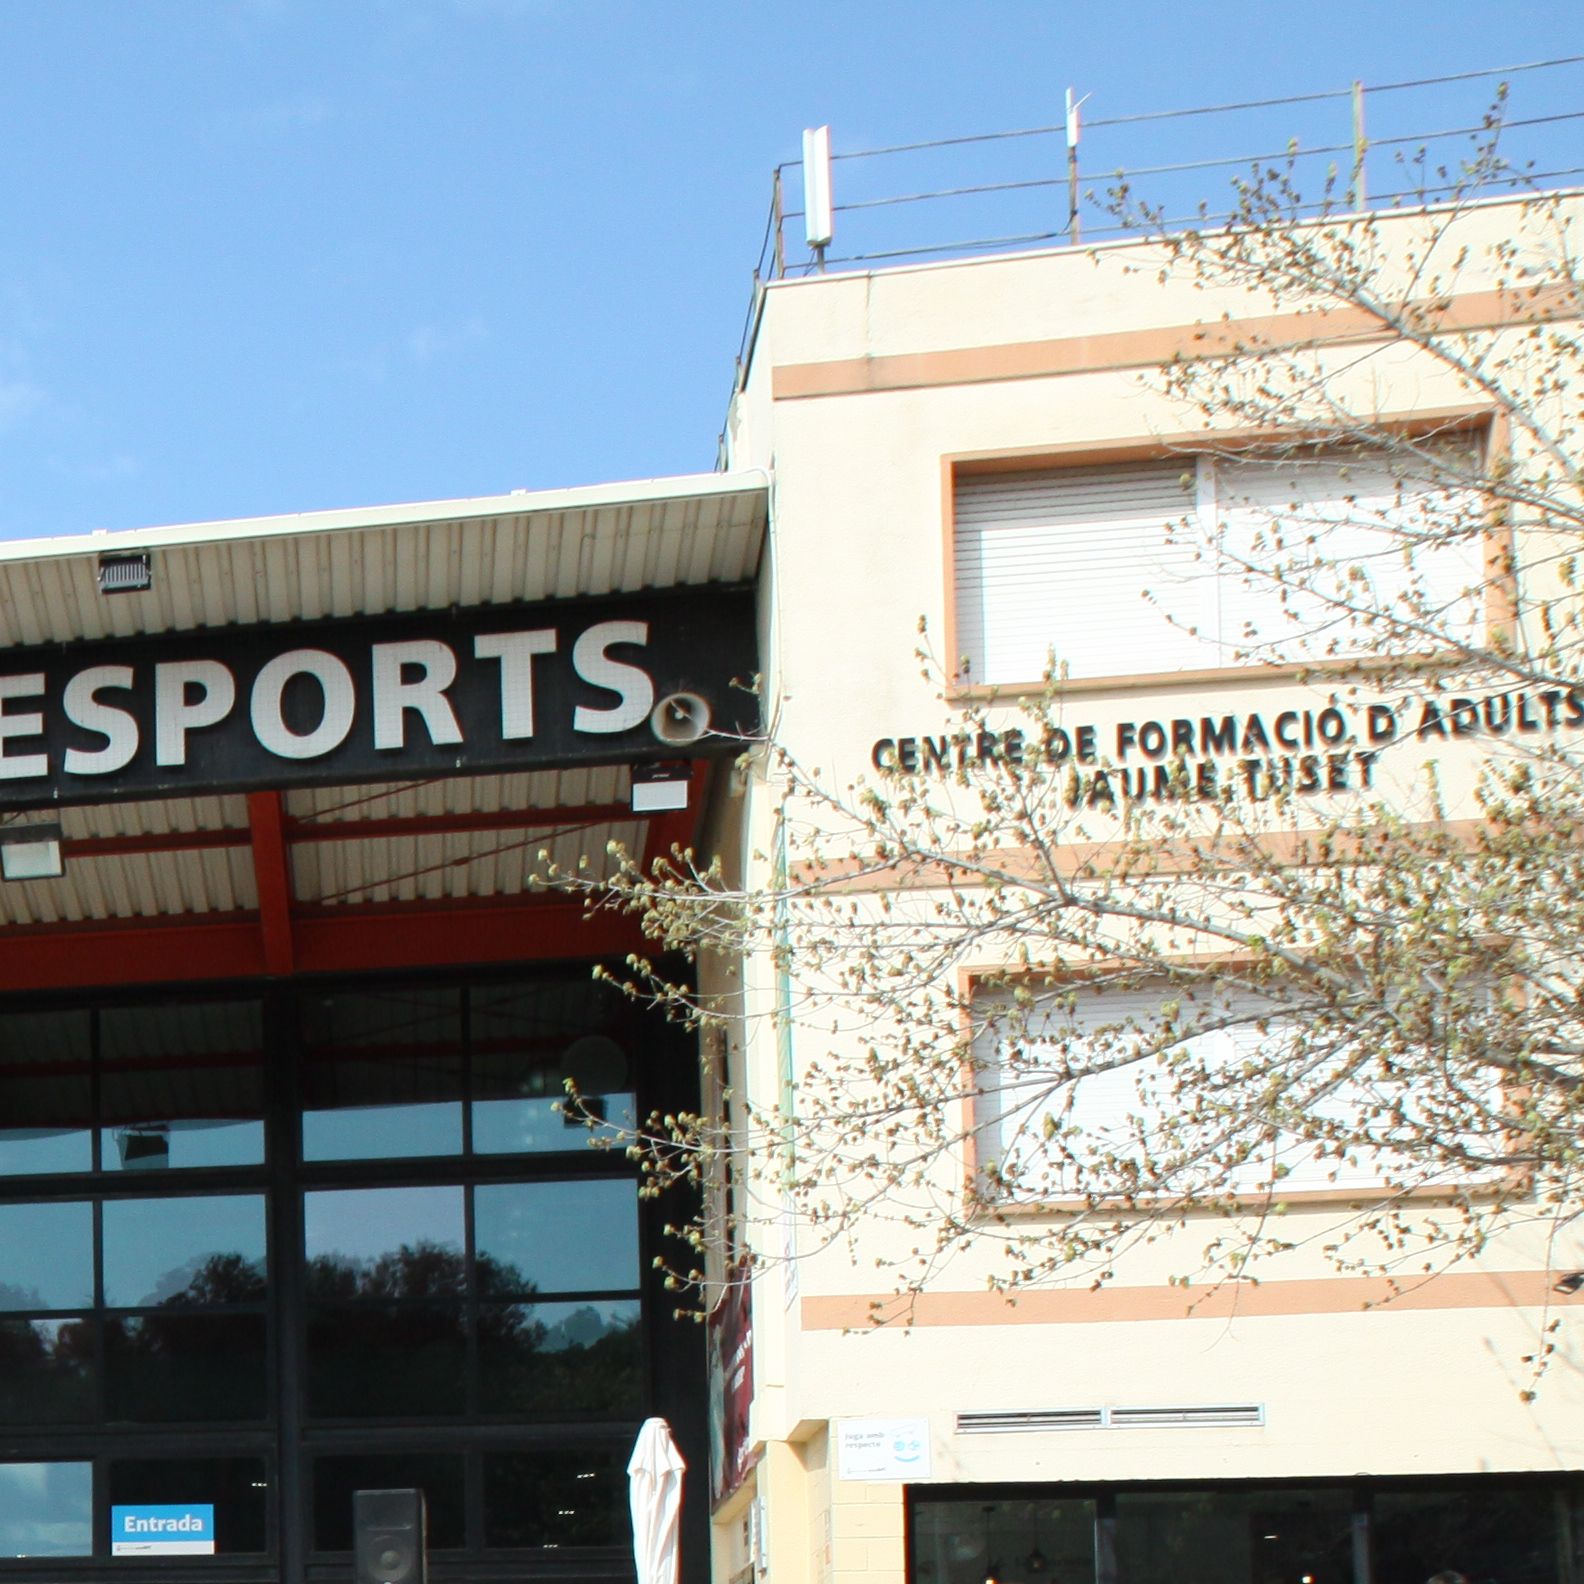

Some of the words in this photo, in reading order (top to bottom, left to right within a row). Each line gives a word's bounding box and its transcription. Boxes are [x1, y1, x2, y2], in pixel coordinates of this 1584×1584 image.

[871, 729, 1025, 775] CENTRE
[1041, 725, 1096, 765] DE
[1116, 694, 1347, 763] FORMACIÓ
[1237, 750, 1381, 803] TUSET
[124, 1514, 203, 1532] Entrada
